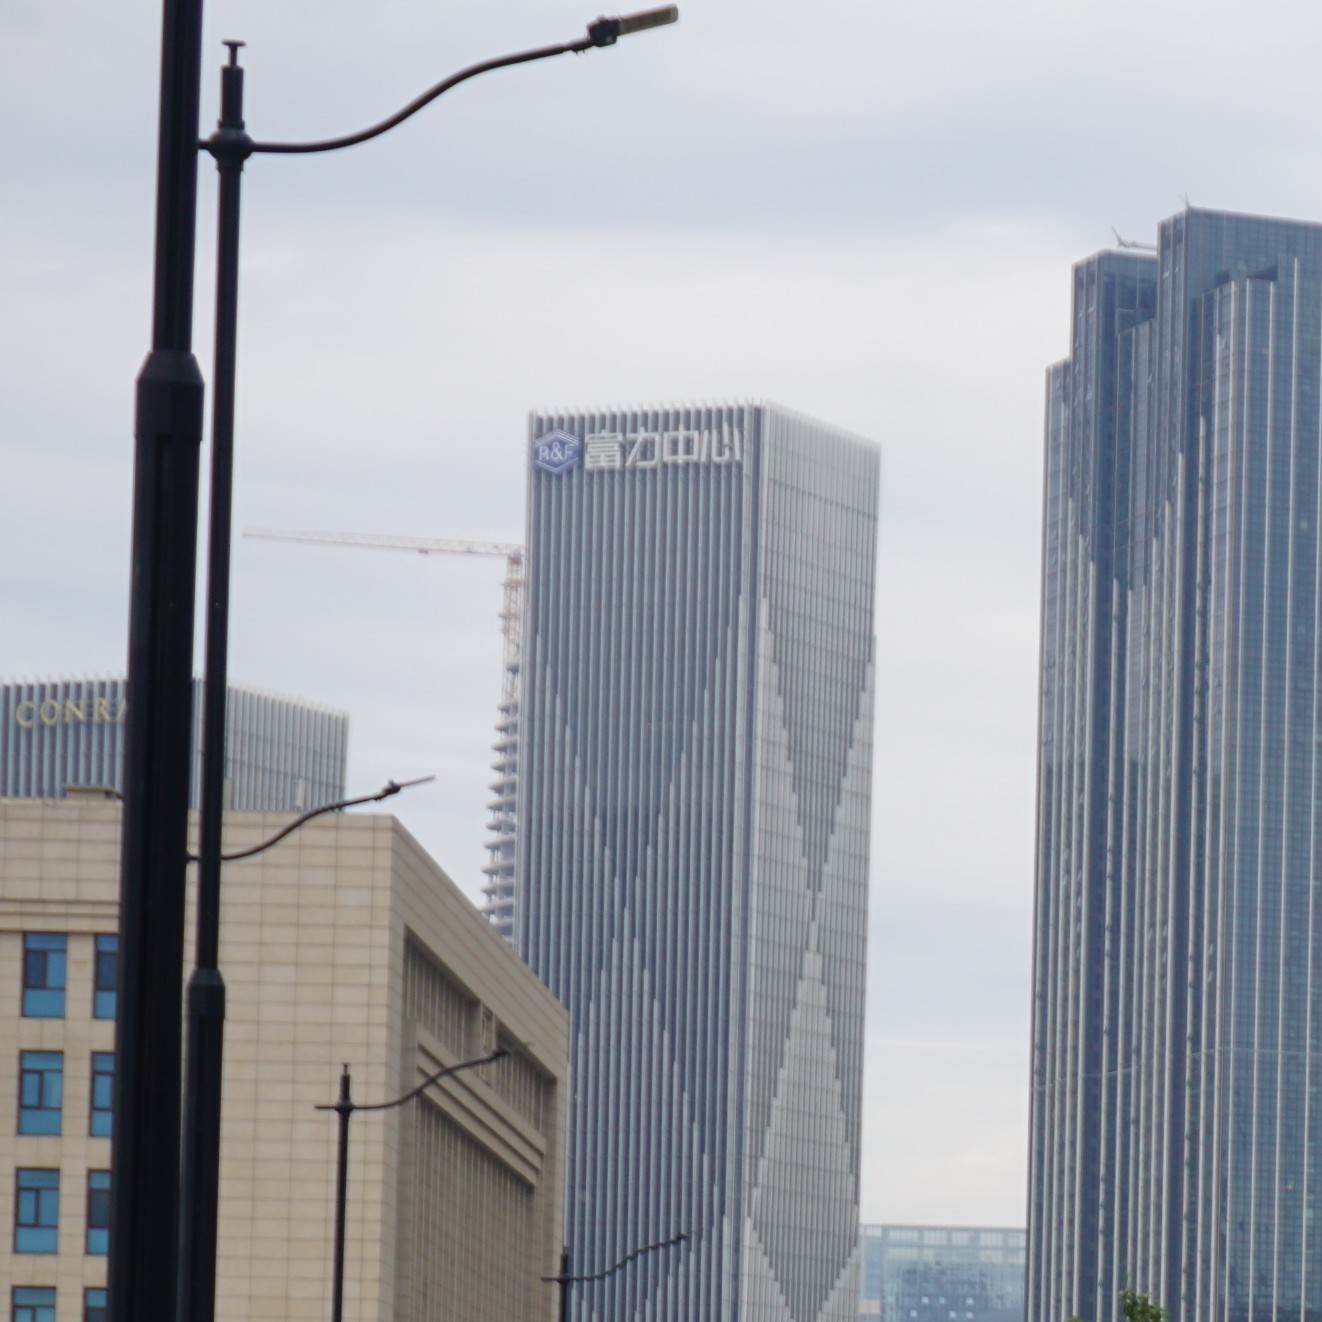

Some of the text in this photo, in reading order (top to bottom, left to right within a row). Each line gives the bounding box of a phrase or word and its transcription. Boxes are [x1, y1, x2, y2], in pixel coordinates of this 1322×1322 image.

[538, 441, 574, 462] R&F
[584, 421, 742, 471] 富力中心
